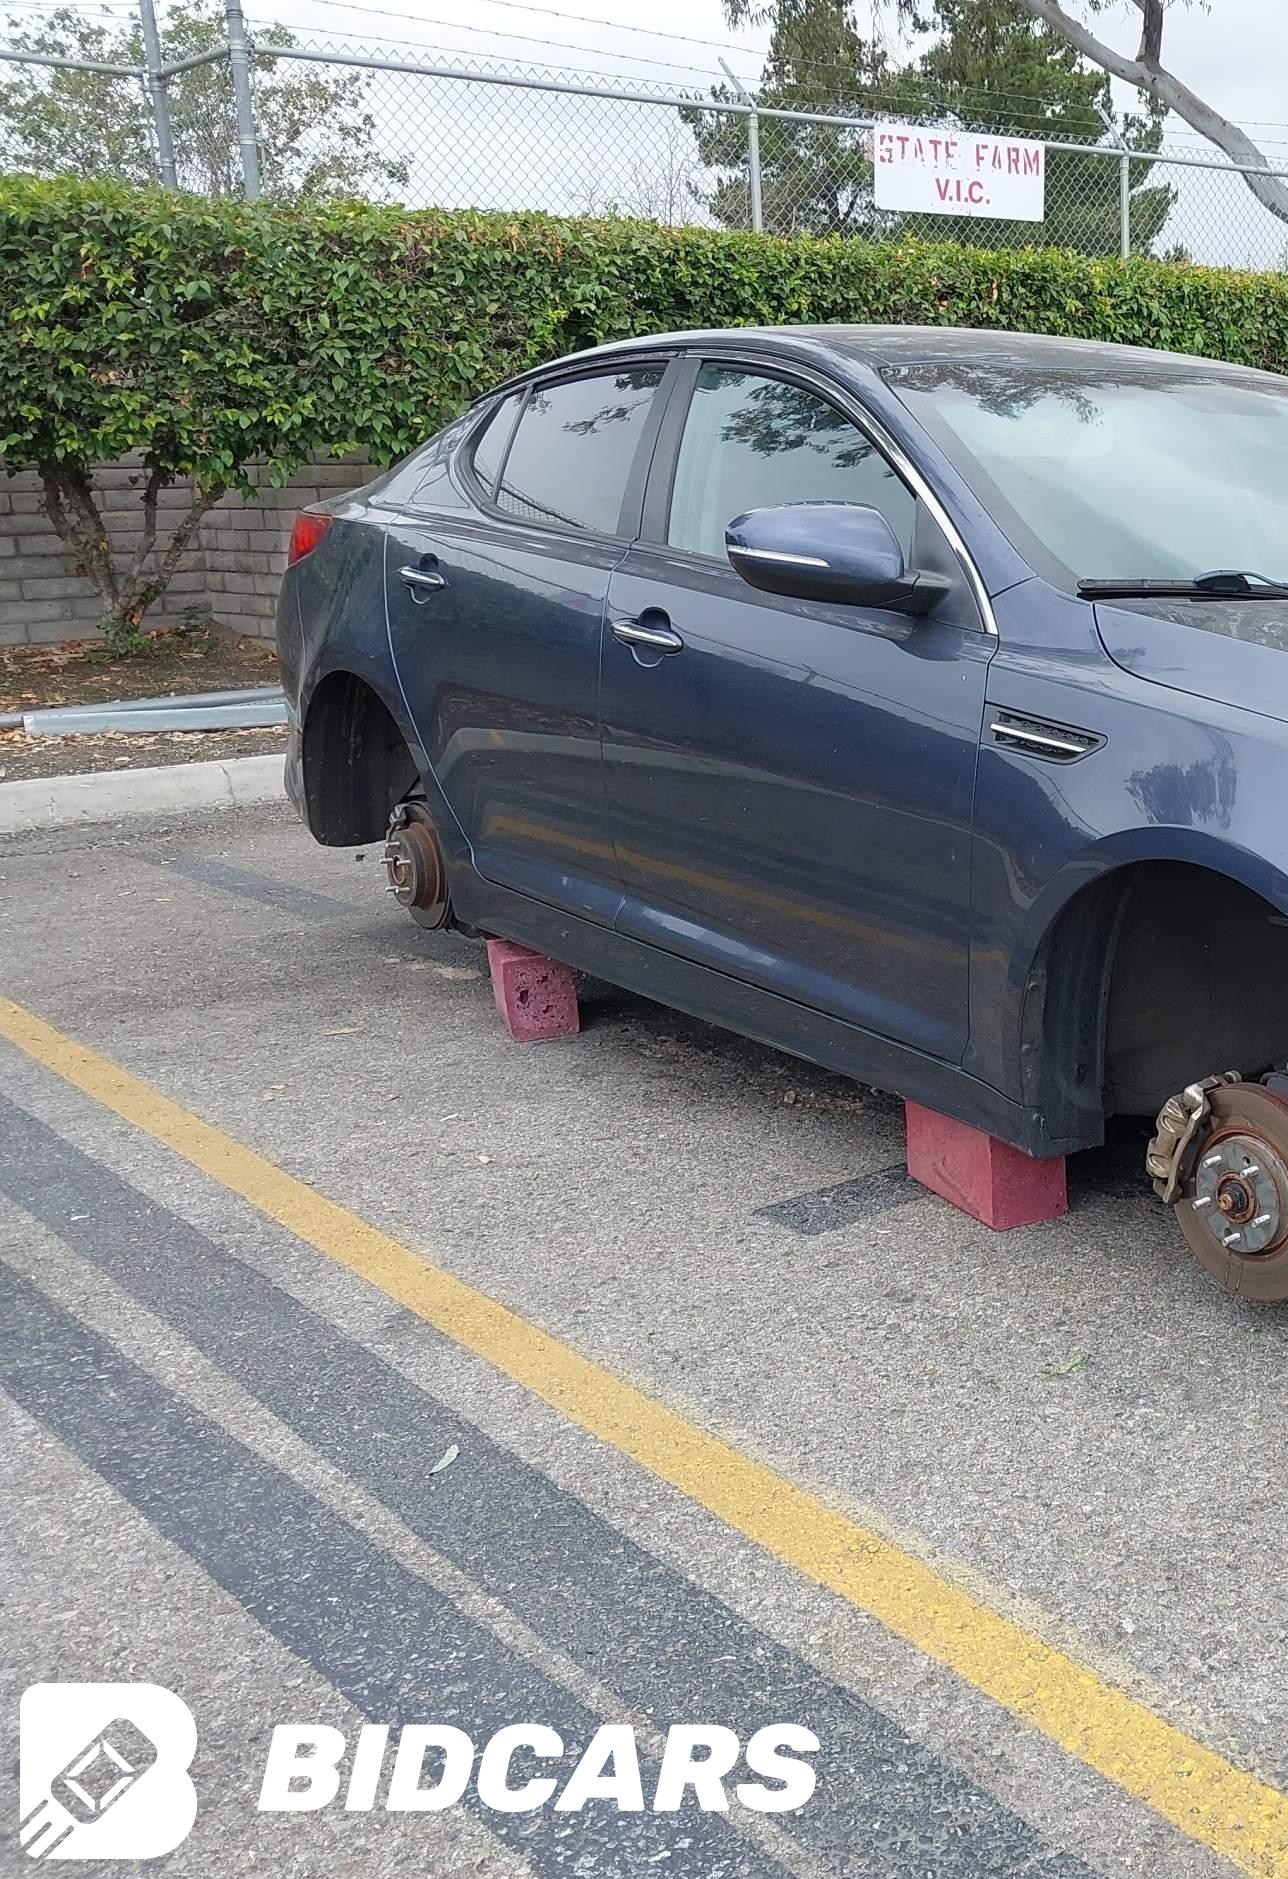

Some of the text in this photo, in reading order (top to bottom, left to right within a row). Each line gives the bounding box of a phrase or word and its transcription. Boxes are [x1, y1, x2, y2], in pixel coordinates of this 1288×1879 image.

[879, 134, 1040, 176] STATE FARM
[935, 178, 991, 205] V.I.C.
